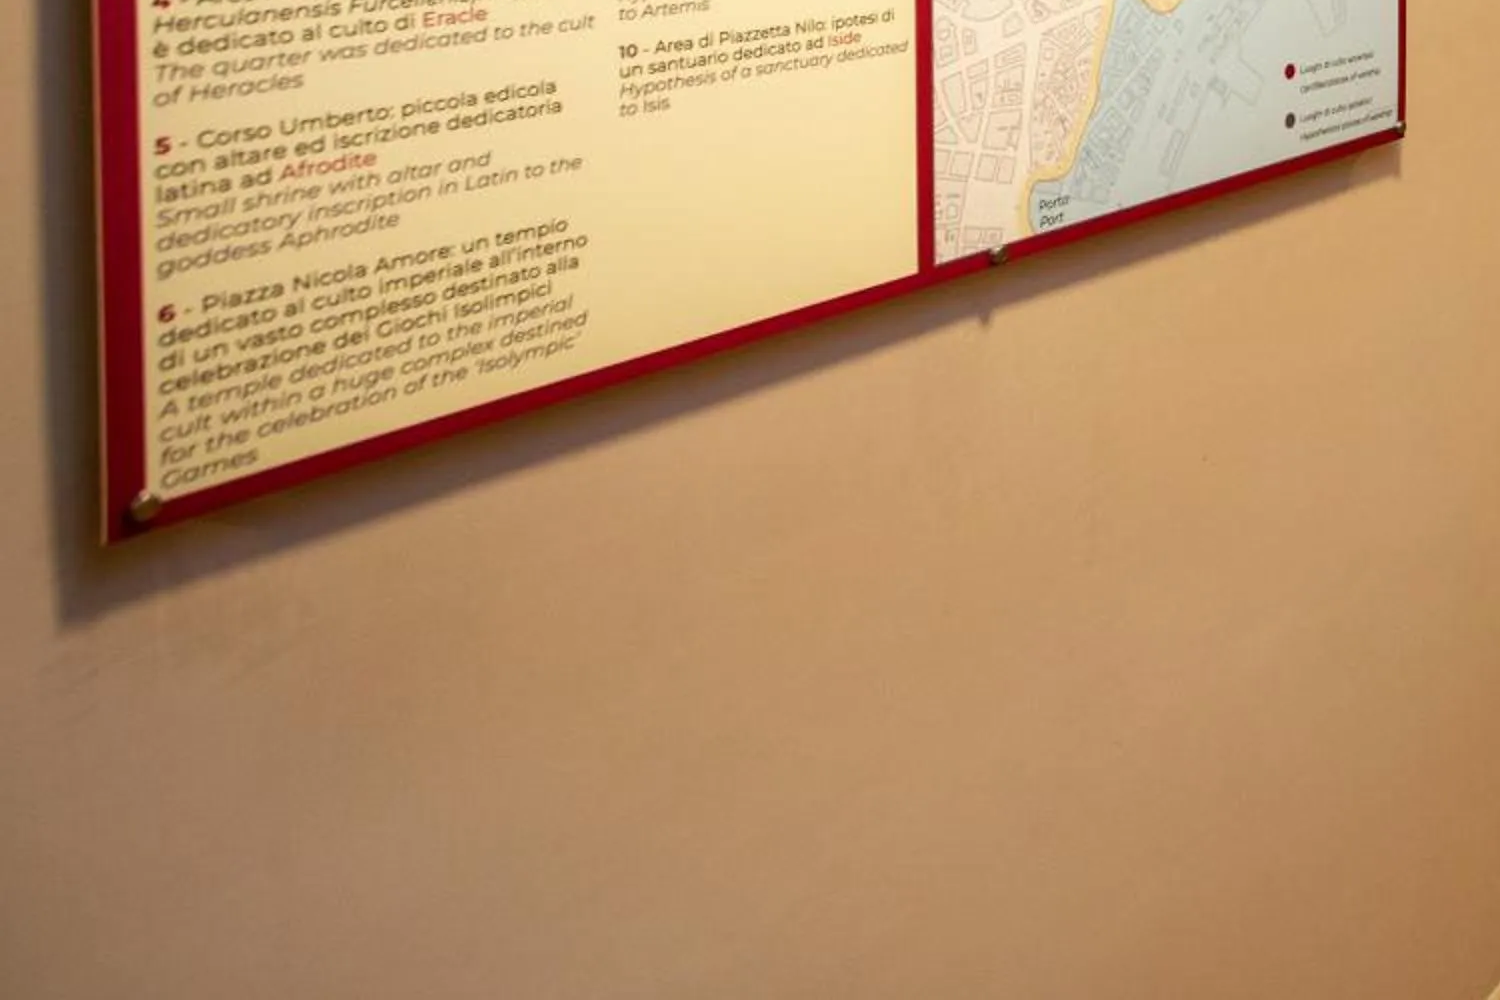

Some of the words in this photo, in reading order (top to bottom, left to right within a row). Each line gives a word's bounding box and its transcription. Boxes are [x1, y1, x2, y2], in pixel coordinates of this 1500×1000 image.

[152, 38, 169, 59] è
[176, 28, 294, 56] dedicato
[301, 21, 322, 42] al
[328, 17, 389, 39] culto
[394, 11, 416, 31] di
[421, 5, 489, 28] Eracle
[618, 6, 637, 21] to
[618, 64, 643, 80] un
[647, 49, 729, 75] santuario
[732, 39, 802, 62] dedicato
[805, 33, 824, 50] ad
[827, 29, 861, 47] Iside
[188, 72, 305, 102] Heracles
[642, 94, 671, 113] Isis
[153, 133, 172, 155] 5
[196, 123, 272, 149] Corso
[400, 90, 478, 121] piccola
[483, 79, 557, 105] edicola
[154, 176, 233, 204] latina
[239, 165, 273, 189] ad
[279, 150, 378, 182] Afrodite
[1040, 195, 1070, 210] Porto
[1040, 212, 1064, 228] Port
[155, 239, 272, 282] goddess
[277, 212, 400, 251] Aphrodite
[156, 301, 176, 324] 6
[201, 281, 284, 314] Piazza
[292, 261, 368, 293] Nicola
[461, 236, 489, 255] un
[495, 217, 570, 247] tempio
[157, 339, 326, 396] celebrazione
[332, 323, 370, 351] dei
[375, 304, 448, 339] Giochi
[453, 277, 554, 319] Isolimpici
[159, 447, 260, 490] Games
